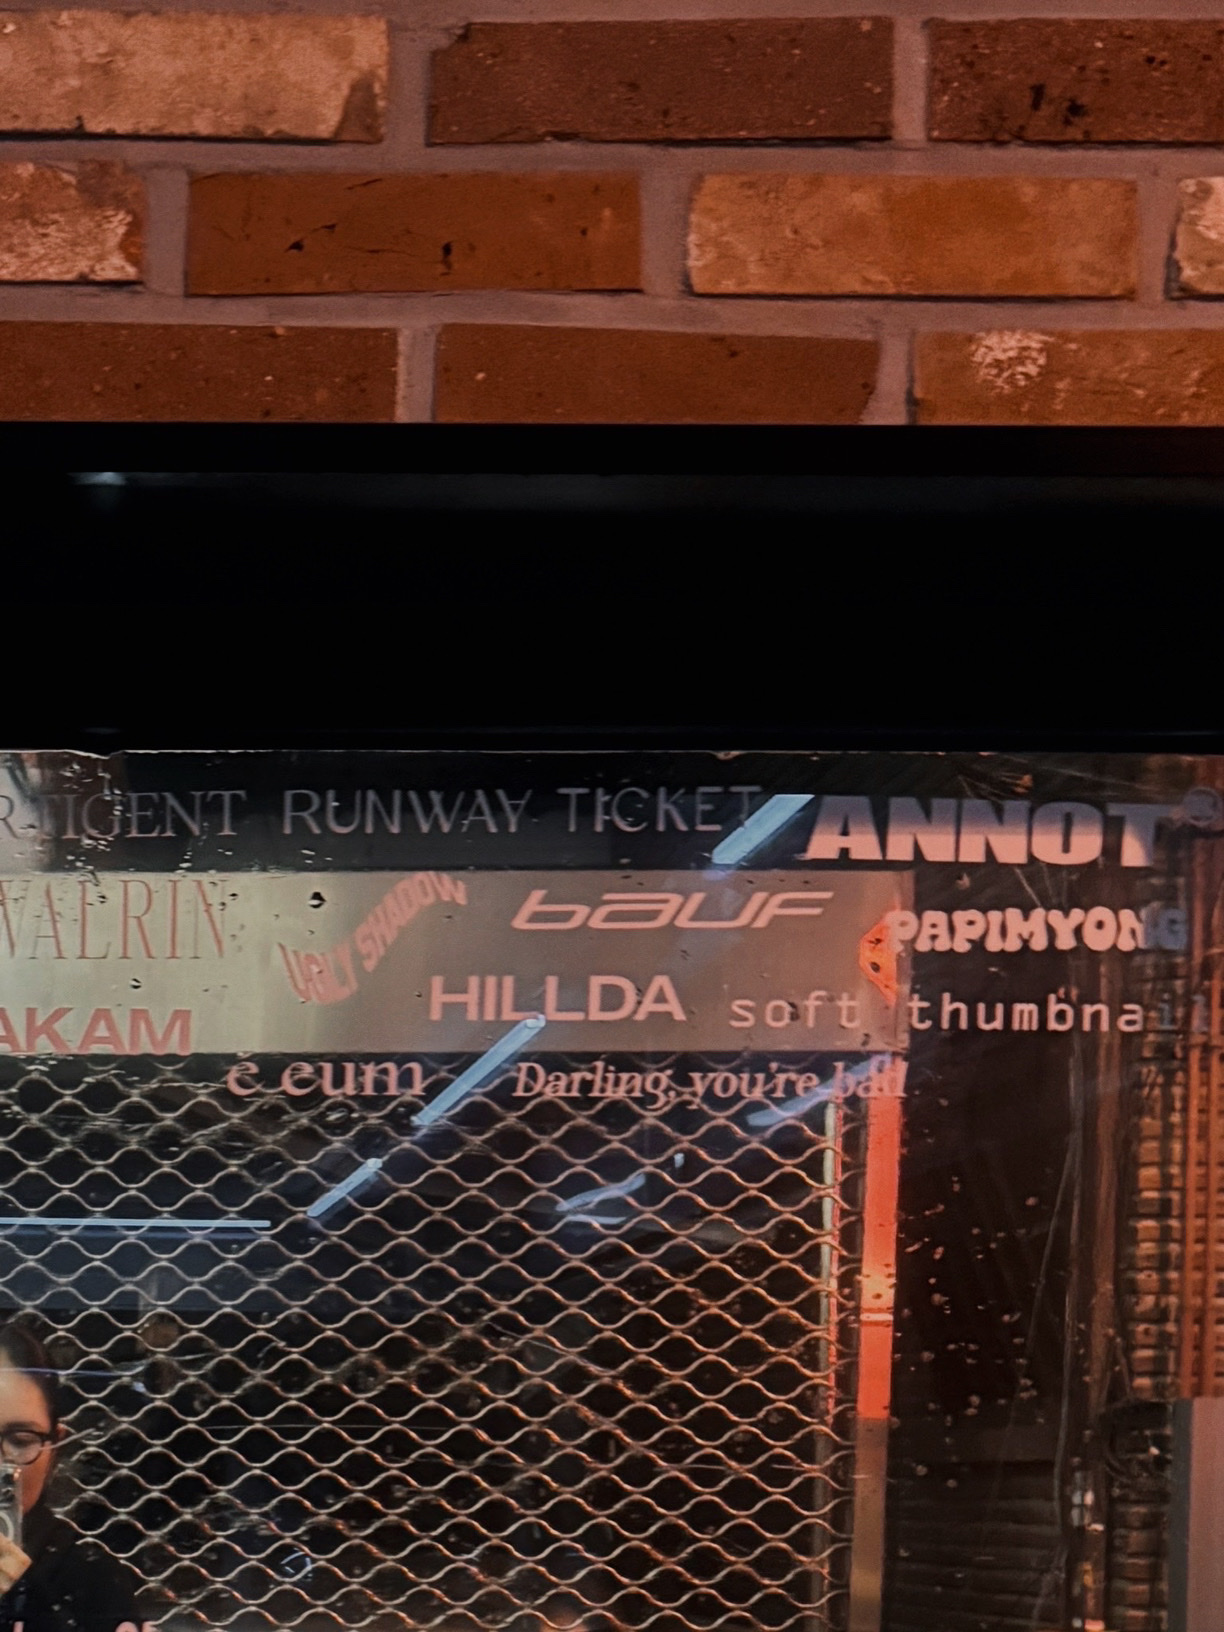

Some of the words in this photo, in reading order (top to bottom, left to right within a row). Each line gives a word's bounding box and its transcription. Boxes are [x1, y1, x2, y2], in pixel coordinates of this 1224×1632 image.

[282, 788, 533, 835] RUNWAY
[556, 786, 764, 834] TICKET
[805, 795, 1174, 868] ANNOT
[355, 870, 469, 974] SHADOW
[428, 975, 687, 1022] HILLDA
[729, 990, 862, 1030] soft
